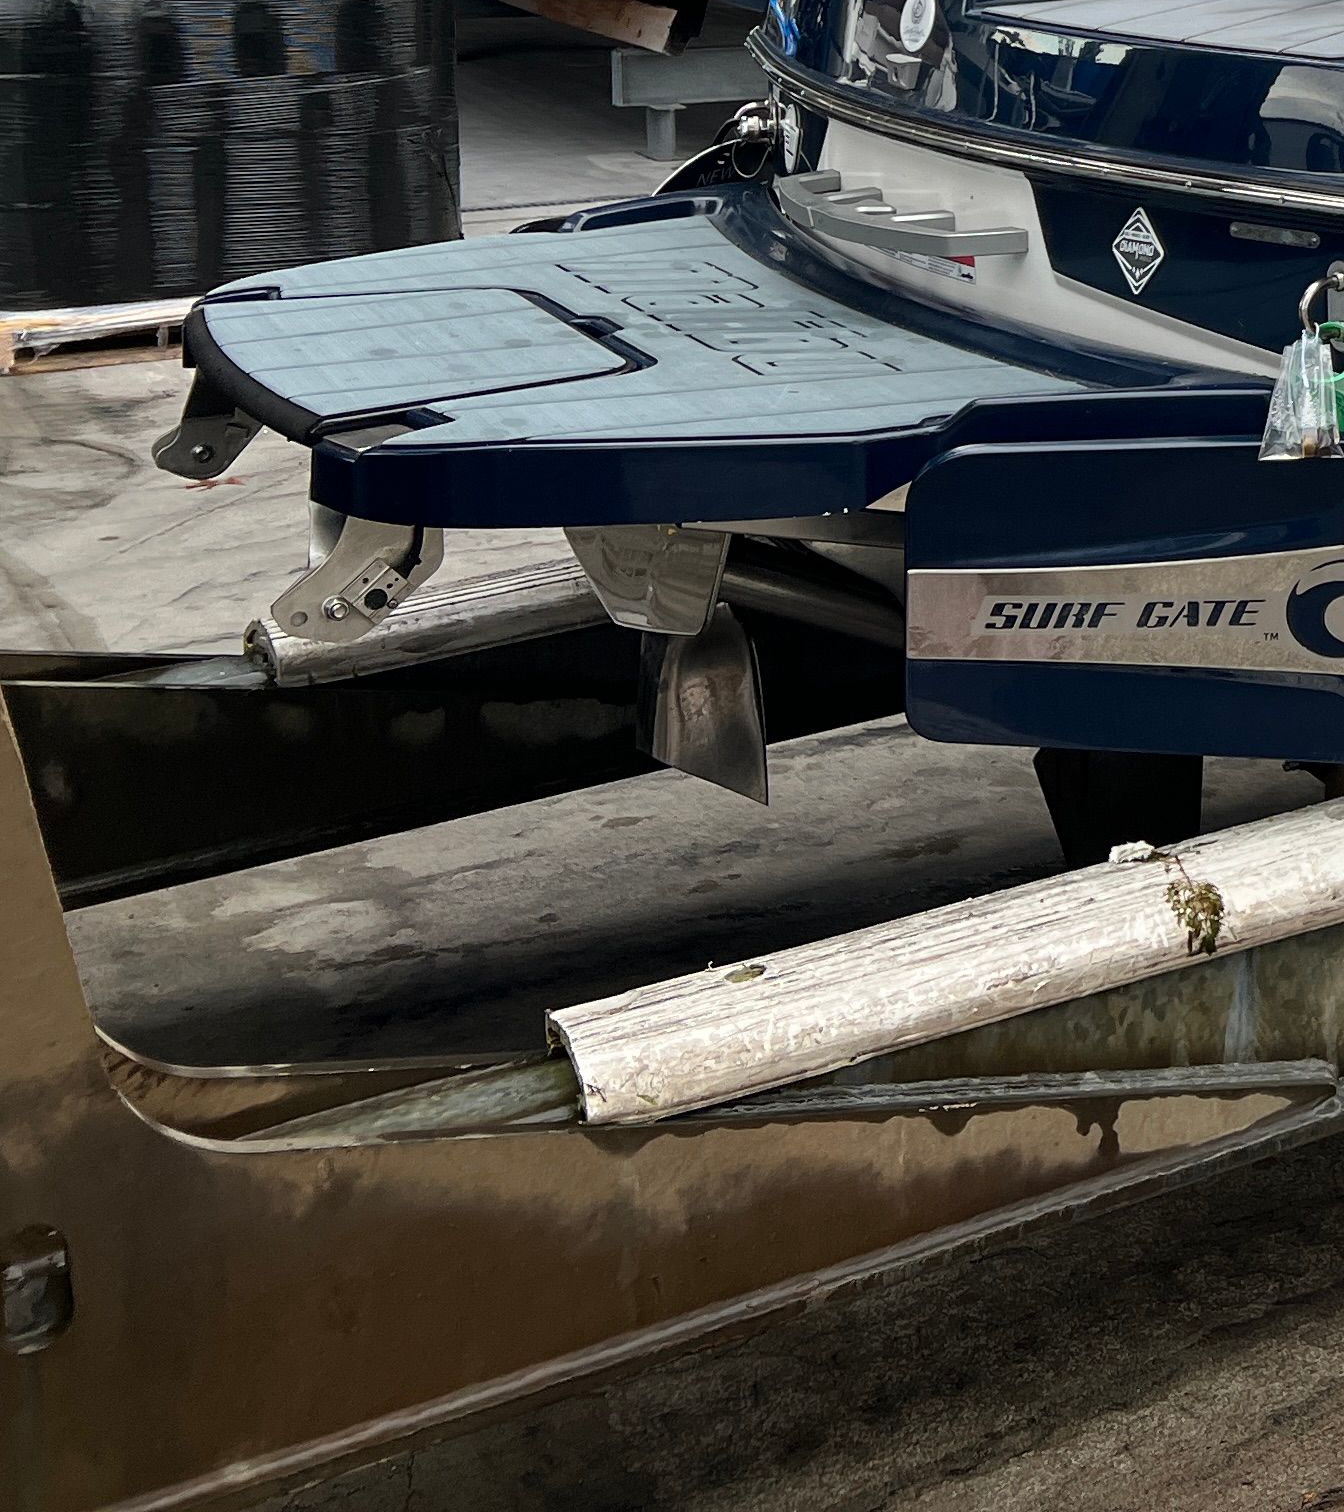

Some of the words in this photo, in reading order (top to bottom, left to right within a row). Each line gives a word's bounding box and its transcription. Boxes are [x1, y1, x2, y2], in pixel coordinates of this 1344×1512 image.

[697, 166, 735, 186] NEW
[984, 601, 1125, 631] SURF
[1136, 598, 1267, 629] GATE
[1263, 632, 1280, 641] TM
